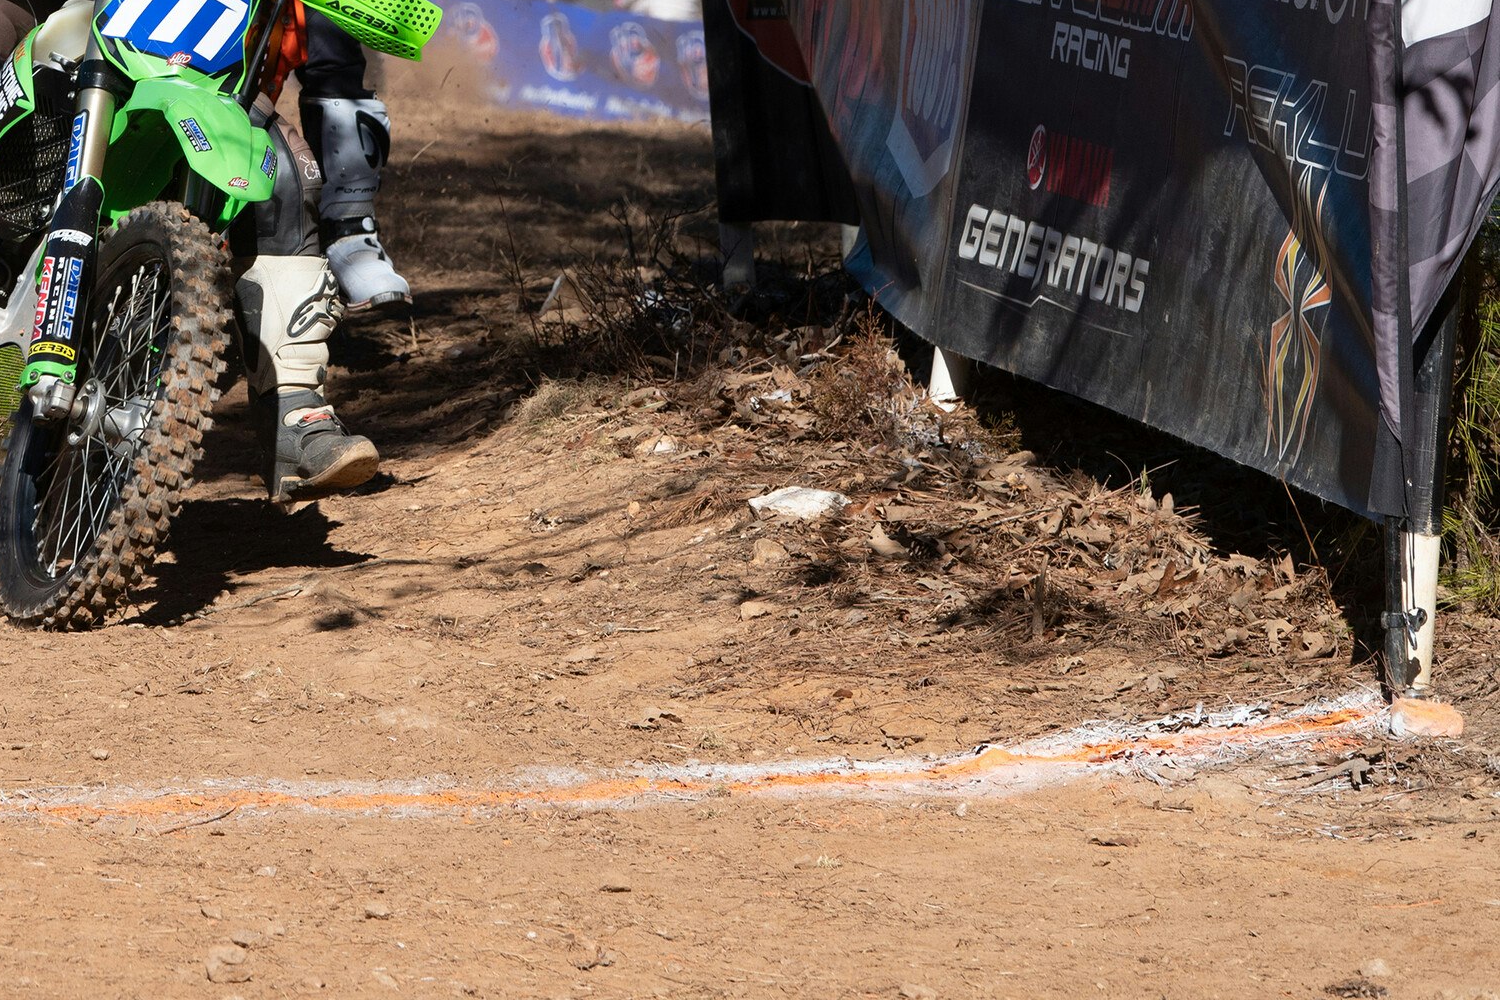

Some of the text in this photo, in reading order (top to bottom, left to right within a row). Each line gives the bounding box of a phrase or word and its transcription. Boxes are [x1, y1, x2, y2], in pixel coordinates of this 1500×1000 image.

[325, 0, 399, 35] ACERBIS
[334, 186, 377, 194] Forma
[45, 257, 66, 335] RACING
[56, 257, 84, 340] DAIGLE
[957, 202, 1152, 315] GENERATORS
[30, 257, 55, 342] KENDA
